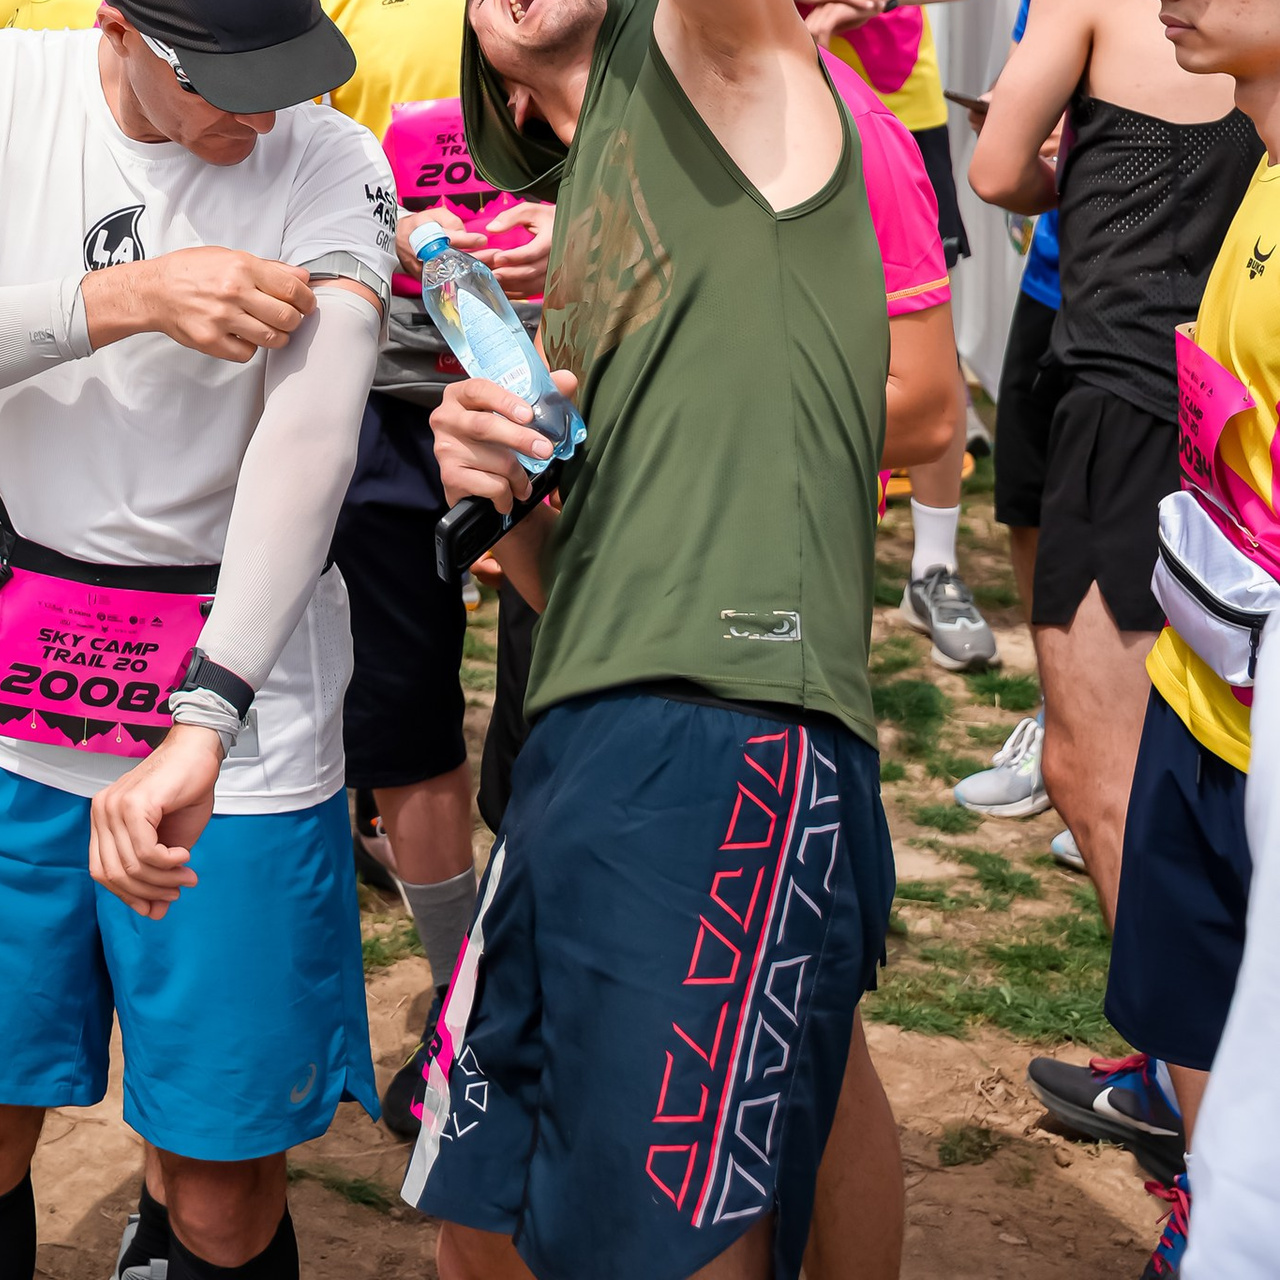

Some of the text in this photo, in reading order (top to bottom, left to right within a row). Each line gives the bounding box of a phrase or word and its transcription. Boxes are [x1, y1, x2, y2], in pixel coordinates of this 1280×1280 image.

[1246, 257, 1265, 277] BUKA
[36, 627, 159, 657] SKY CAMP
[41, 645, 148, 673] TRAIL 20
